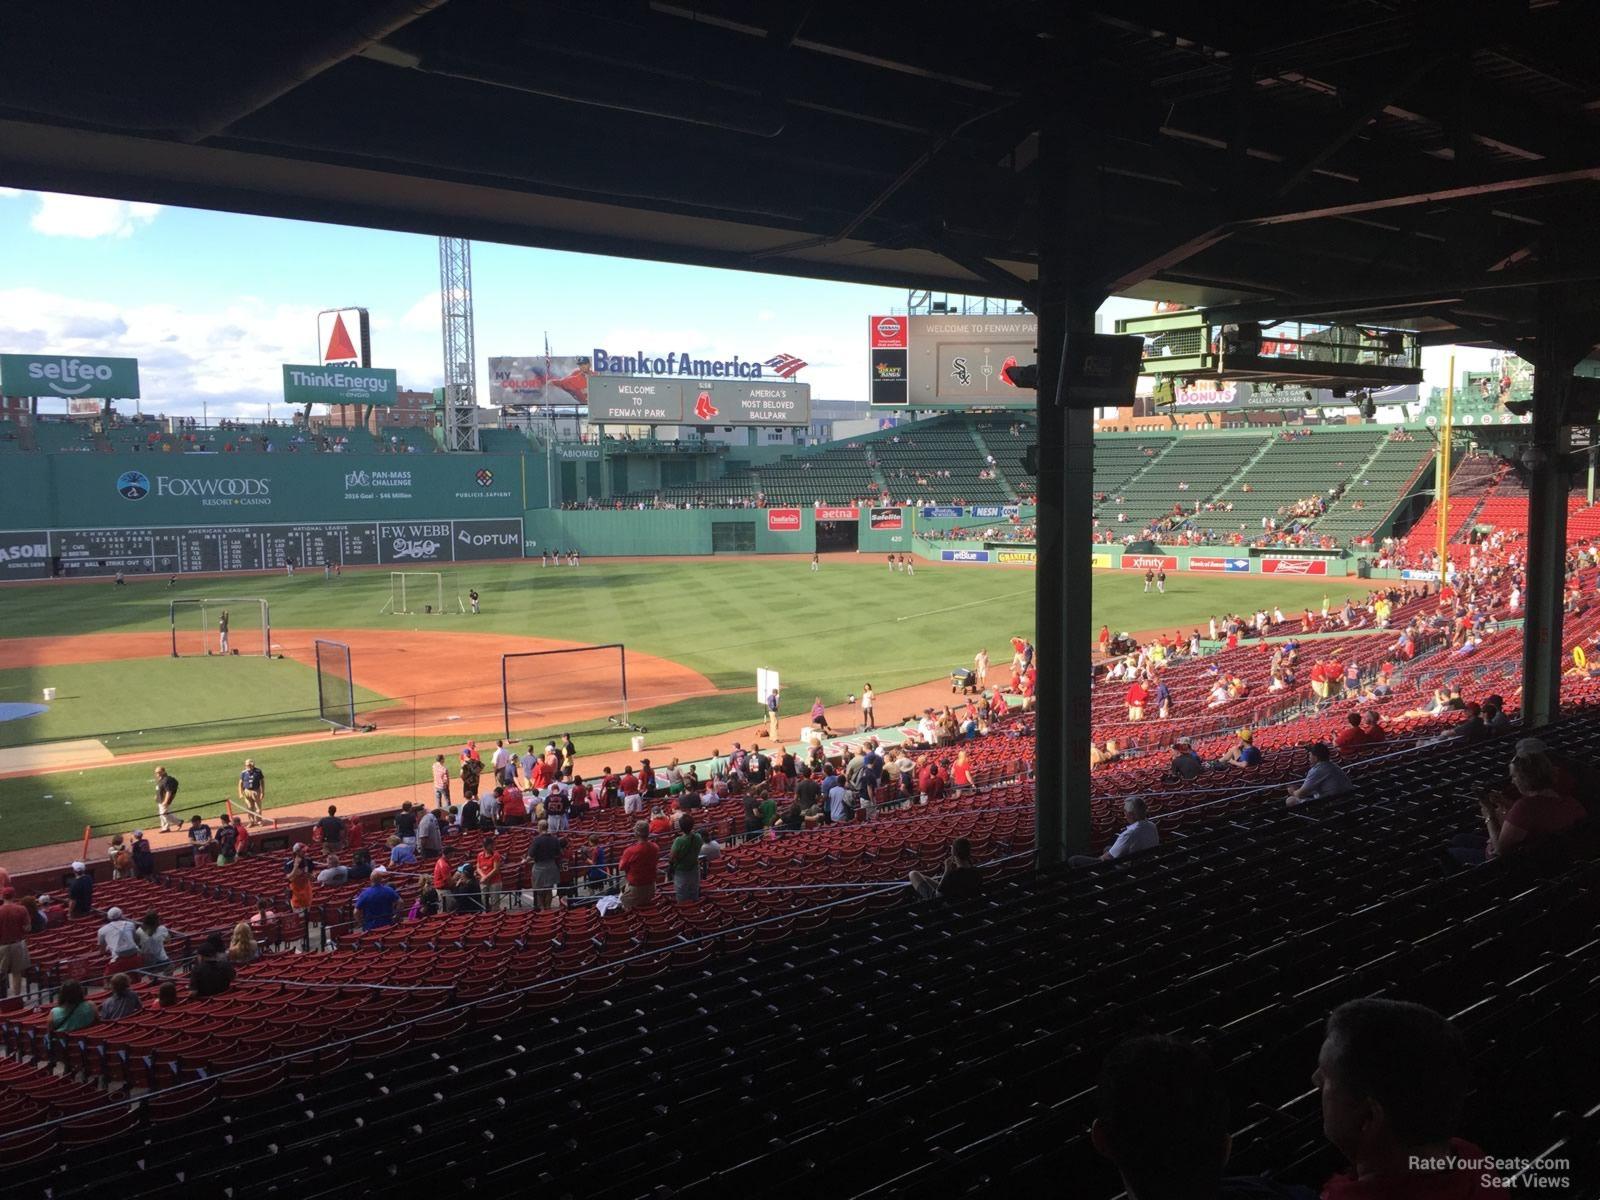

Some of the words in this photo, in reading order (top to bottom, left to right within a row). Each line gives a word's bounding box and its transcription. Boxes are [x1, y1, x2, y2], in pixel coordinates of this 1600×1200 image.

[927, 324, 968, 333] WELCOME
[971, 324, 982, 333] TO
[984, 324, 1019, 333] FENWAY
[594, 348, 650, 375] Bank
[654, 352, 675, 374] of
[678, 353, 762, 378] America
[290, 372, 387, 392] ThinkEnergy
[618, 385, 656, 395] WELCOME
[749, 389, 786, 398] AMERICA'S
[632, 397, 642, 406] TO
[1181, 391, 1232, 403] DONUTS
[741, 401, 760, 409] MOST
[763, 401, 794, 409] BELOVED
[608, 408, 641, 417] FENWAY
[645, 409, 666, 417] PARK
[750, 411, 786, 420] BALLPARK
[562, 449, 600, 458] ABIOMED
[372, 471, 412, 479] PAN-MASS
[157, 476, 269, 496] FOXWOODS
[371, 479, 411, 487] CHALLENGE
[821, 508, 853, 519] aetna
[975, 506, 999, 517] NESN
[381, 526, 406, 538] F.W.
[409, 525, 449, 537] WEBB
[473, 533, 518, 546] OPTUM
[1133, 557, 1164, 569] xfinity
